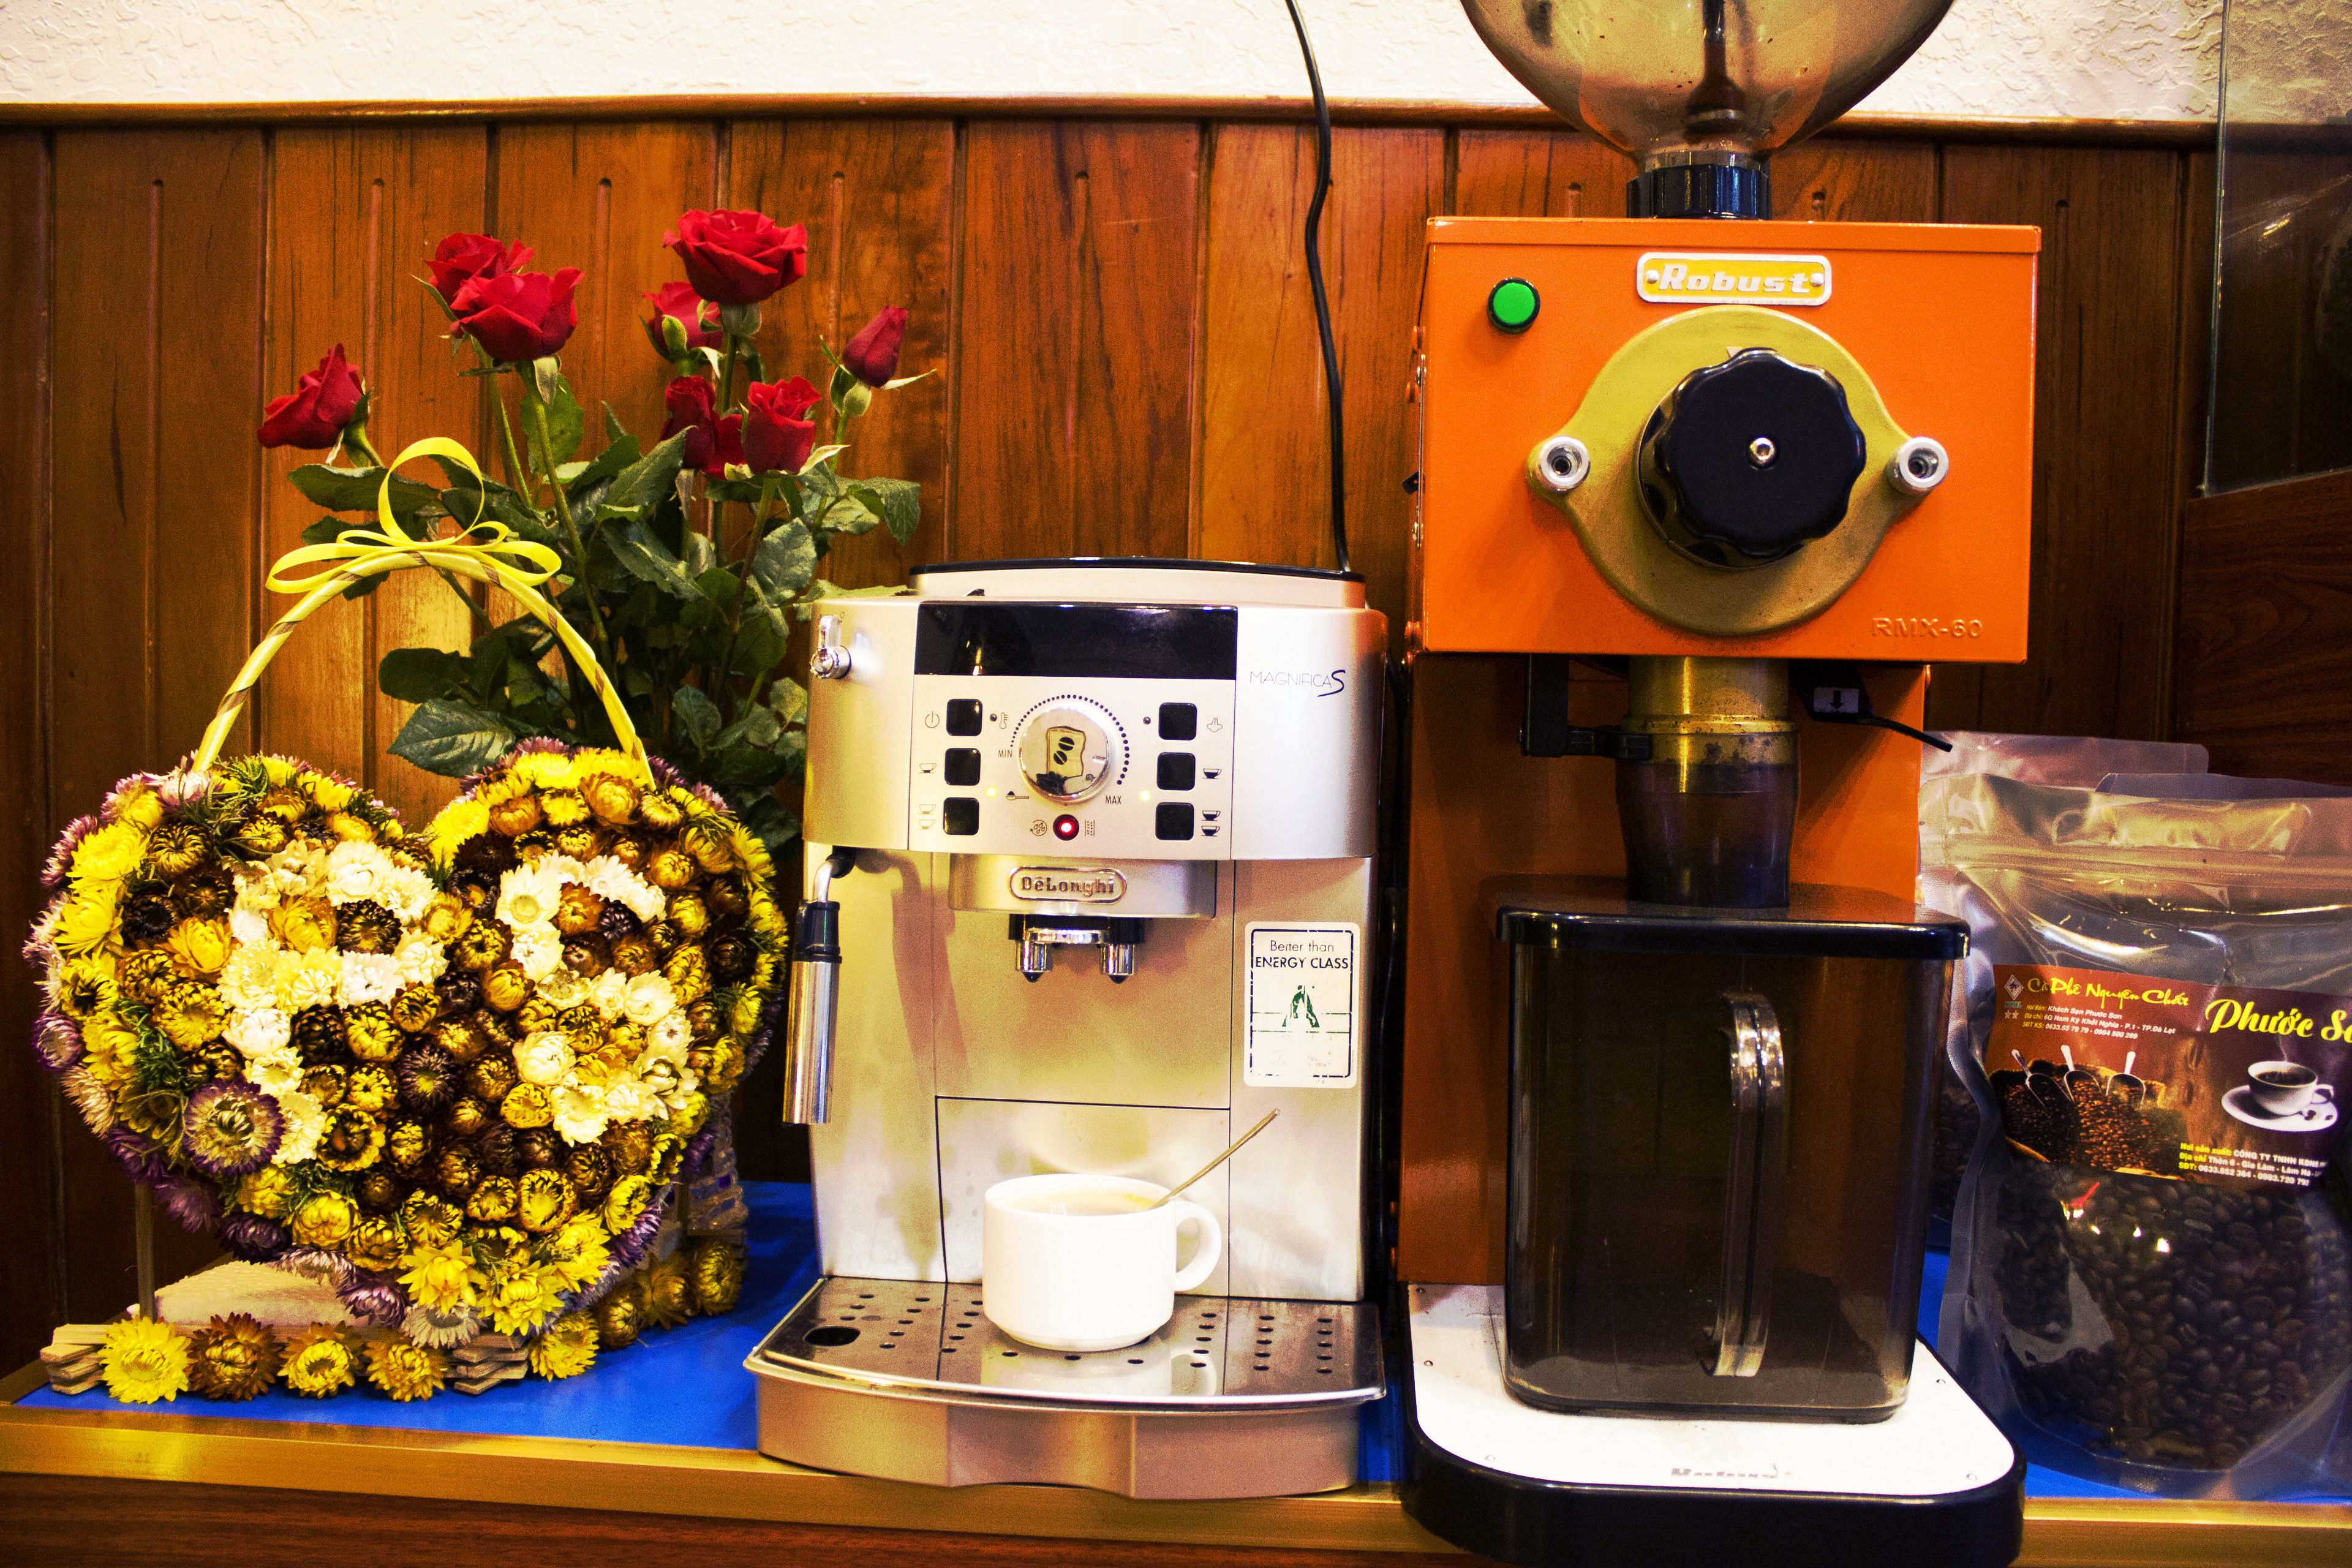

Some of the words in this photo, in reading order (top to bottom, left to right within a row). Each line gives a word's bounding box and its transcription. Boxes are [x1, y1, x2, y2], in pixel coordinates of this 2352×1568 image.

[1659, 263, 1811, 293] Robust
[1872, 617, 1983, 638] RMX-60
[1250, 671, 1332, 688] MAGNIFICA
[998, 749, 1013, 758] MIN
[1106, 796, 1121, 805] MAX
[1309, 941, 1334, 952] than
[1256, 957, 1306, 968] ENERGY
[1311, 958, 1349, 969] CLASS
[2050, 977, 2082, 995] Phê
[2086, 984, 2140, 1009] Nguyên
[2205, 998, 2314, 1038] Phước
[2233, 1149, 2258, 1159] CÔNG
